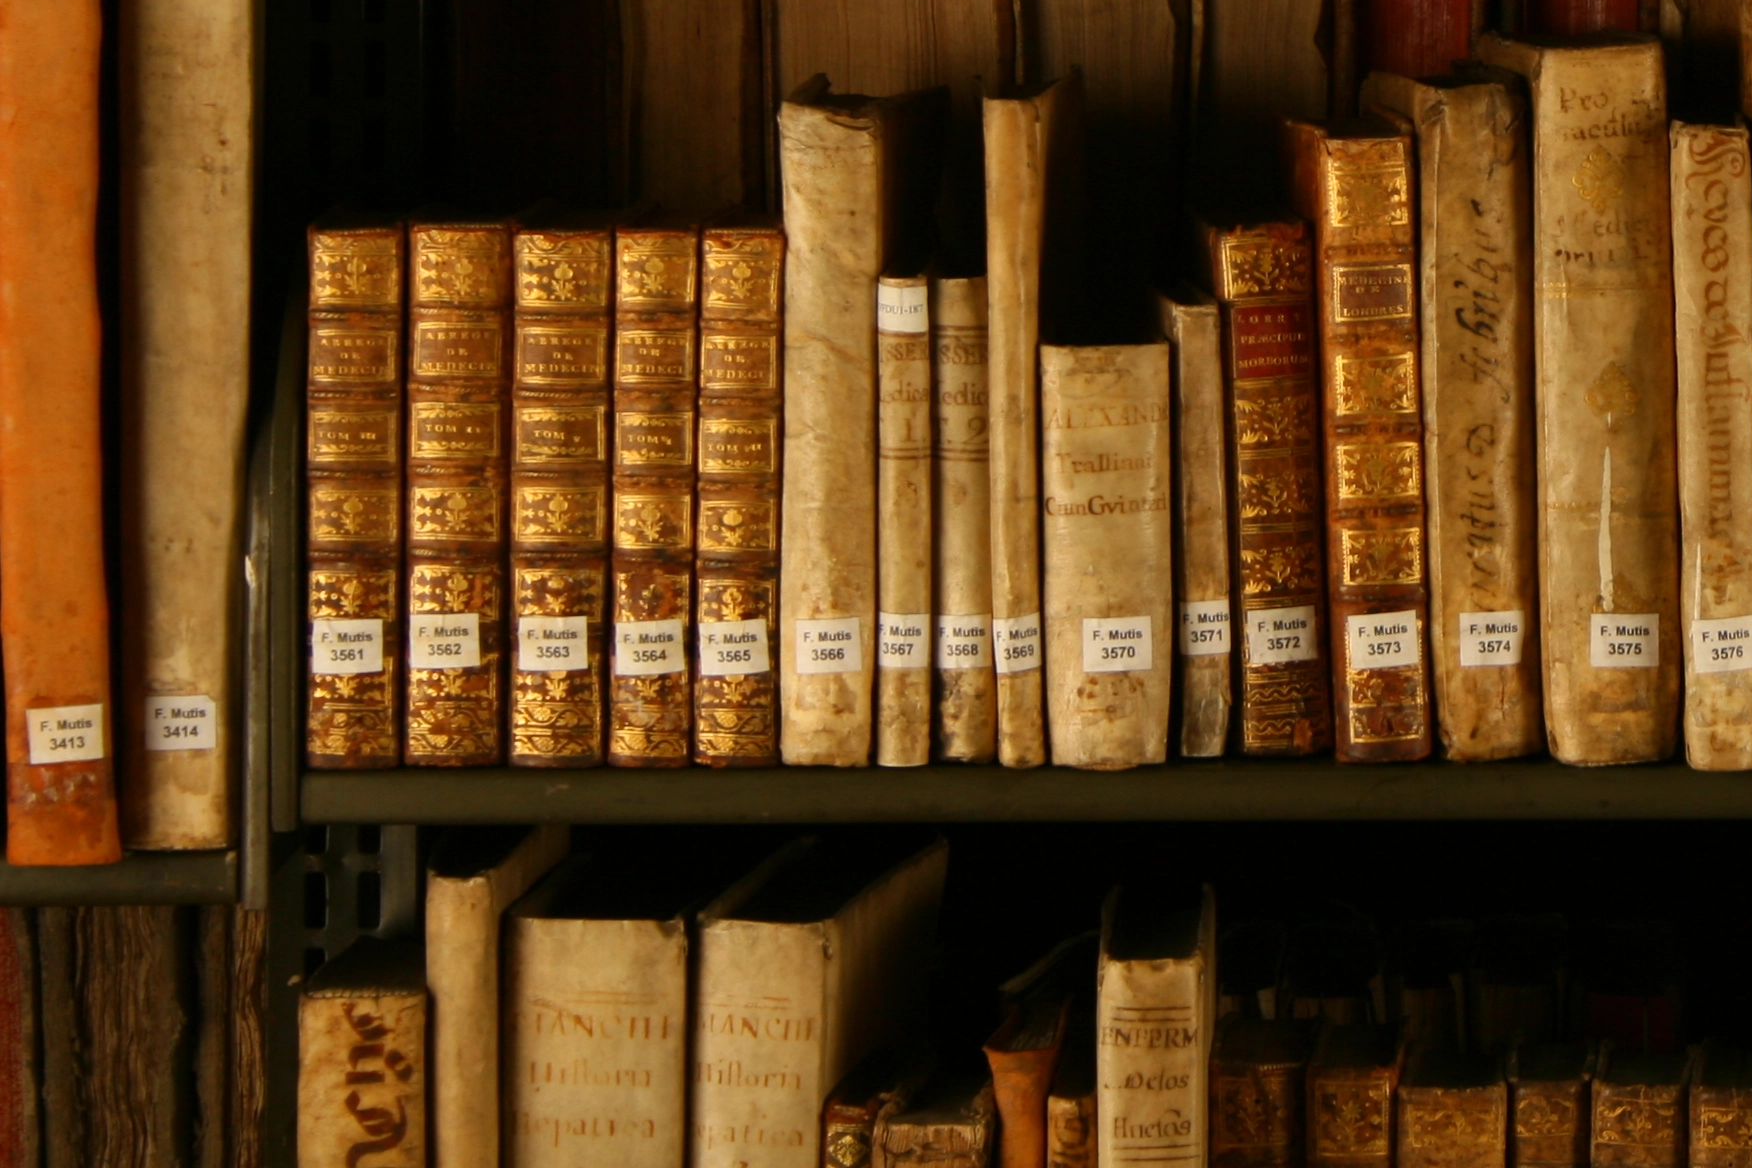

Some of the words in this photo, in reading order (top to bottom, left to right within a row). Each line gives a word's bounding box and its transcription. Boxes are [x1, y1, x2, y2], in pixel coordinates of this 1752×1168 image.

[1342, 305, 1405, 317] LONDRES
[1190, 628, 1223, 644] 3571
[428, 642, 462, 656] 3562
[536, 645, 570, 659] 3563
[882, 642, 914, 656] 3567
[946, 643, 980, 657] 3568
[1266, 637, 1301, 652] 3572
[1367, 640, 1402, 656] 3573
[1478, 639, 1512, 654] 3574
[1608, 642, 1643, 656] 3575
[330, 648, 364, 662] 3561
[632, 648, 668, 663] 3564
[717, 648, 752, 663] 3565
[811, 647, 845, 662] 3566
[1004, 644, 1035, 661] 3569
[1101, 645, 1136, 660] 3570
[1711, 644, 1744, 661] 3576
[154, 708, 167, 719] F.
[170, 707, 206, 719] Mutis
[163, 725, 199, 739] 3414
[49, 735, 86, 751] 3413
